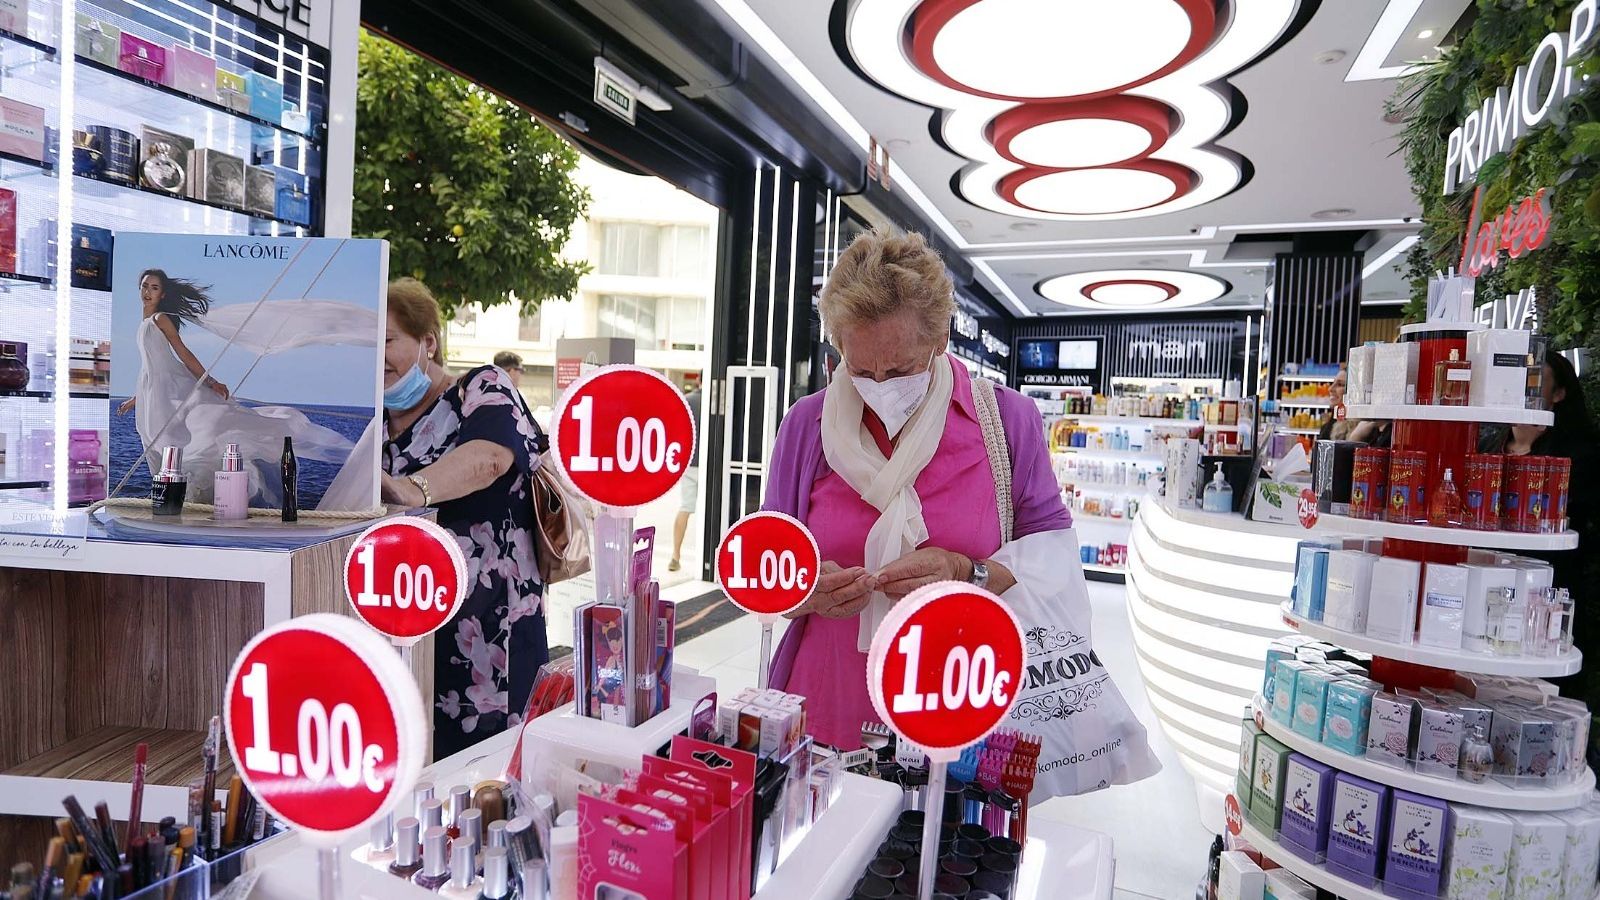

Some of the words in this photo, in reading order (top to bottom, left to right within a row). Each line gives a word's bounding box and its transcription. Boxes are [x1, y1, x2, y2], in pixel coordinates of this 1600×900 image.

[204, 243, 290, 259] LANCÔME
[1024, 374, 1057, 384] GIORGIO
[1059, 374, 1090, 384] ARMANI
[569, 395, 682, 474] 1.00€
[43, 538, 79, 557] belleza
[727, 534, 808, 591] 1.00€
[358, 543, 448, 612] 1.00€
[893, 624, 1010, 713] 1.00€
[242, 661, 385, 793] 1.00€
[1034, 737, 1121, 775] komodo_online
